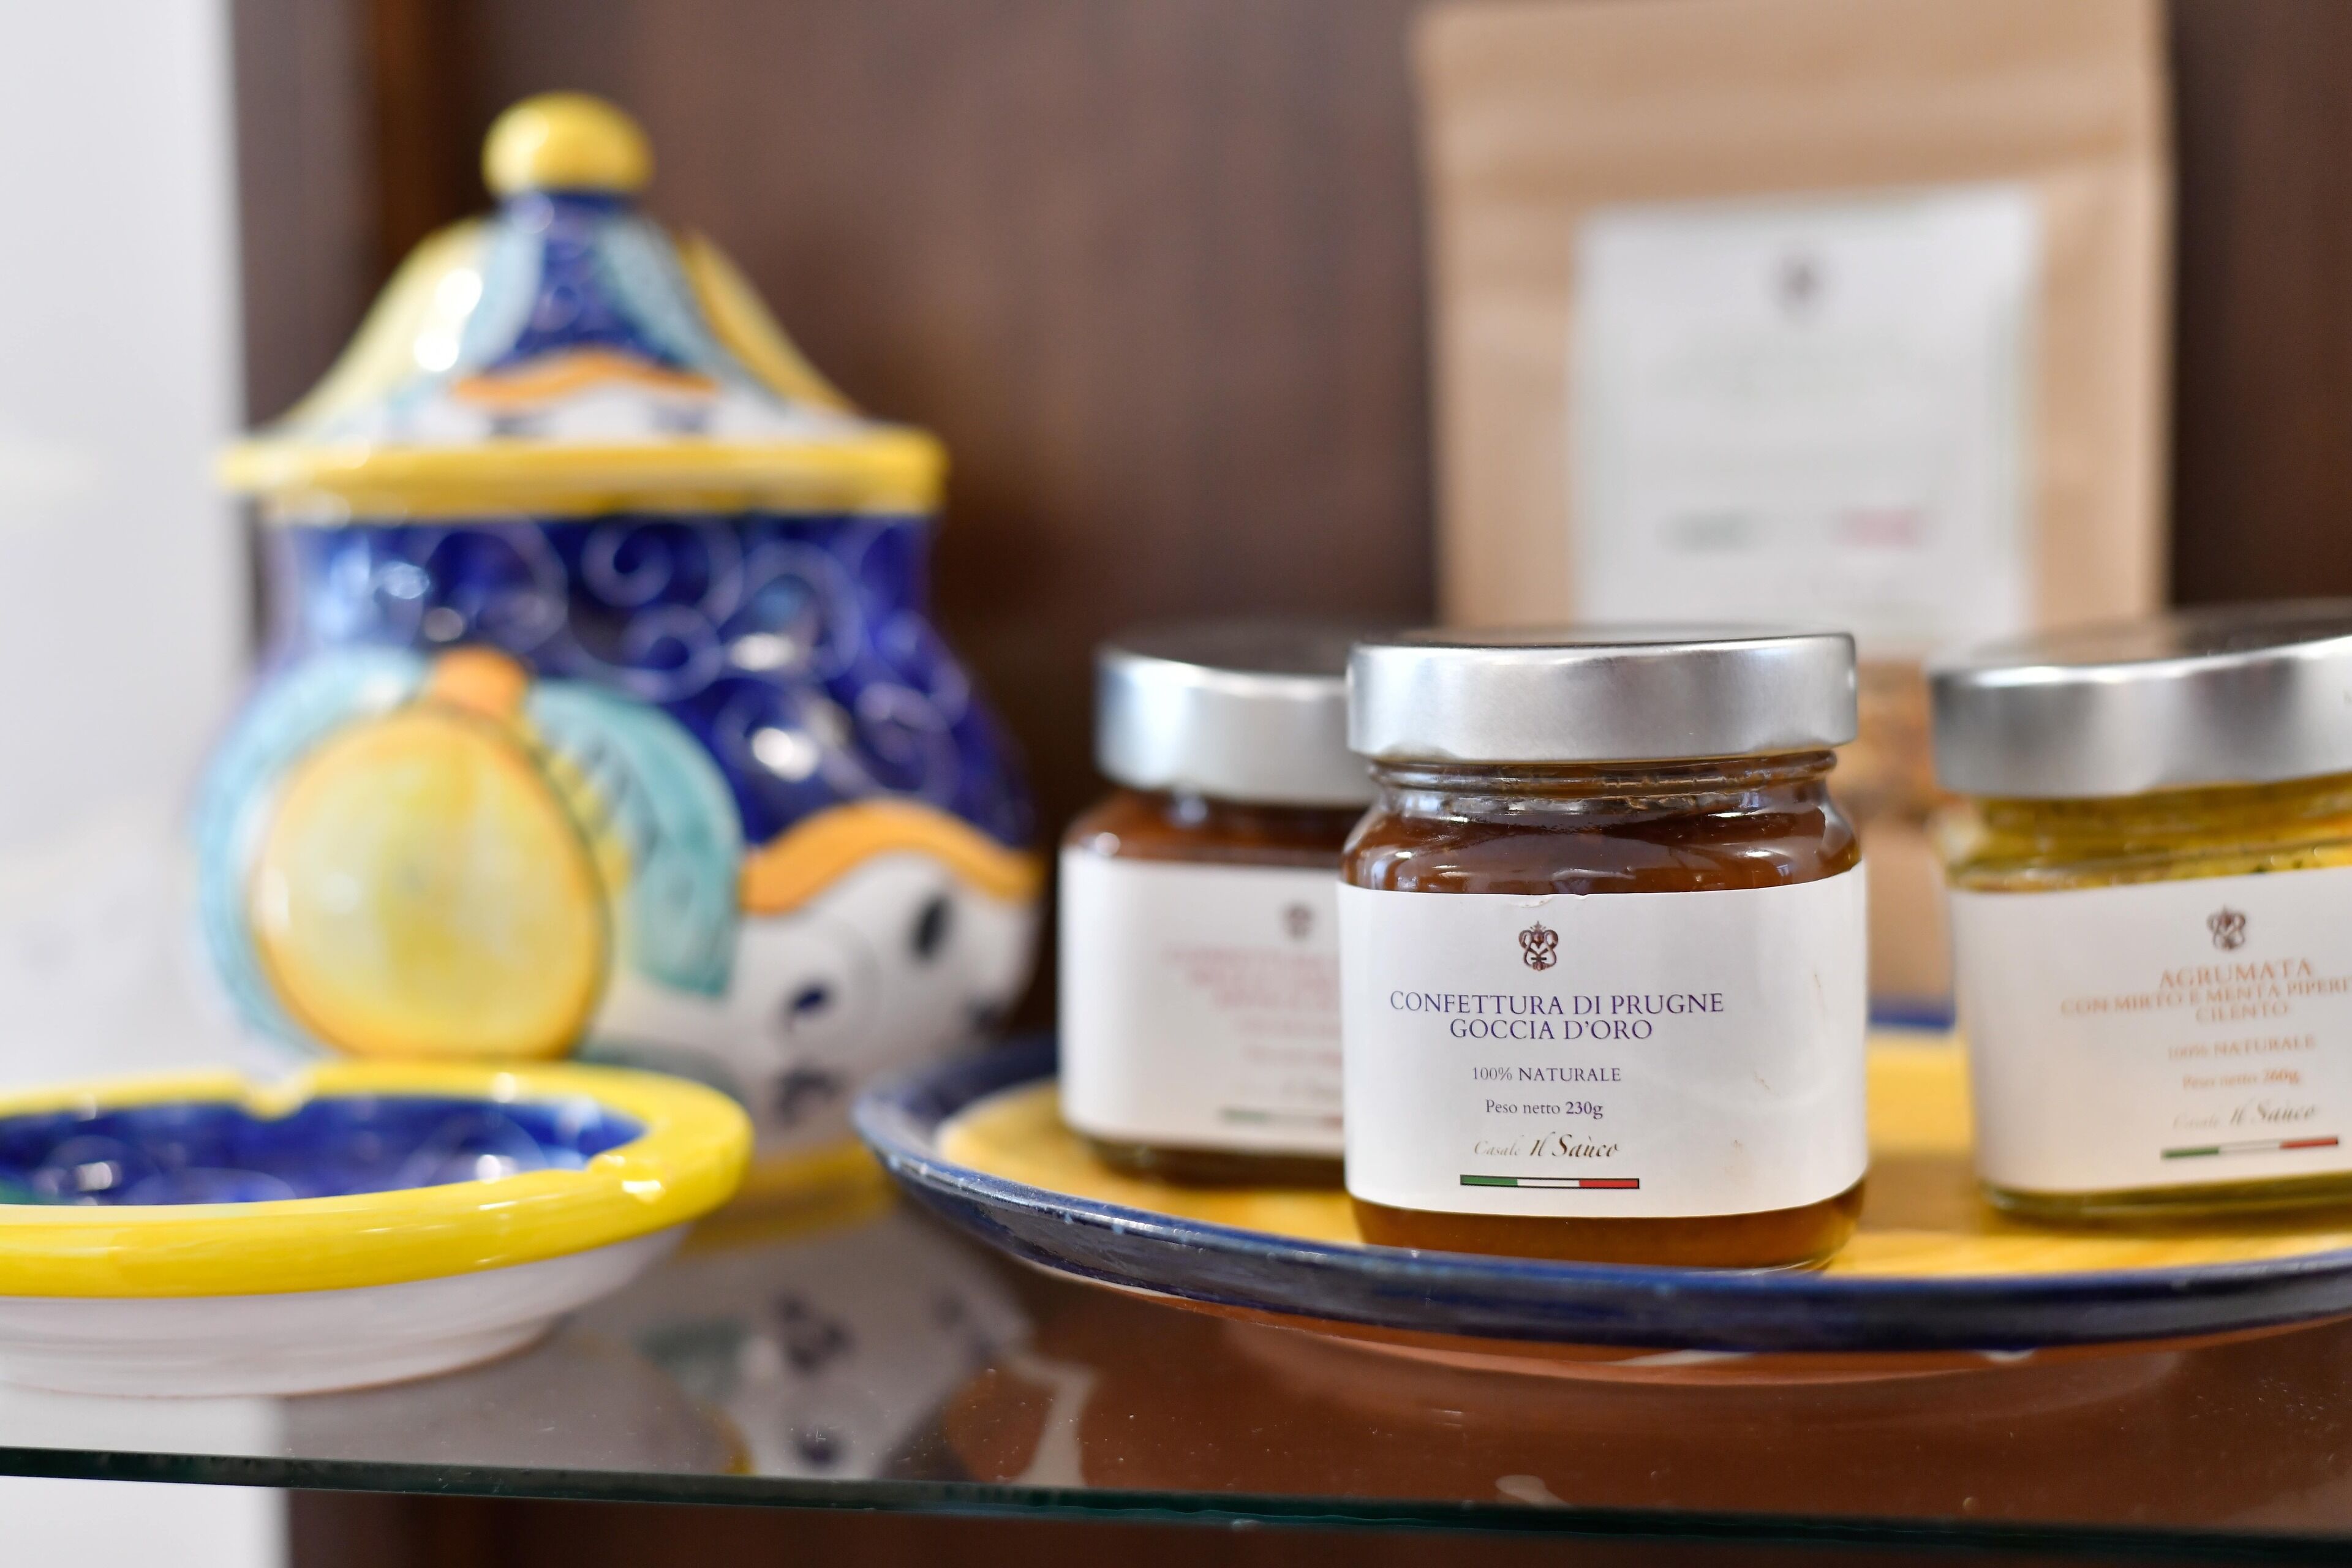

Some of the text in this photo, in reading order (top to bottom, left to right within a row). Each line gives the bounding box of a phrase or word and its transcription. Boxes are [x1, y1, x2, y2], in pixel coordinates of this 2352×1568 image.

[2159, 957, 2312, 989] AGRUMATA
[2206, 981, 2280, 1003] MENTA
[2287, 976, 2352, 997] PIPERI
[1390, 990, 1724, 1016] CONFETTURA DI PRUGNE
[2195, 1002, 2289, 1024] CILENTO
[1450, 1019, 1653, 1040] GOCCIA D'ORO
[2214, 1033, 2315, 1057] NATURALE
[1472, 1066, 1622, 1082] 100% NATURALE
[1485, 1099, 1604, 1120] Peso netto 230g
[1473, 1134, 1525, 1157] Casale
